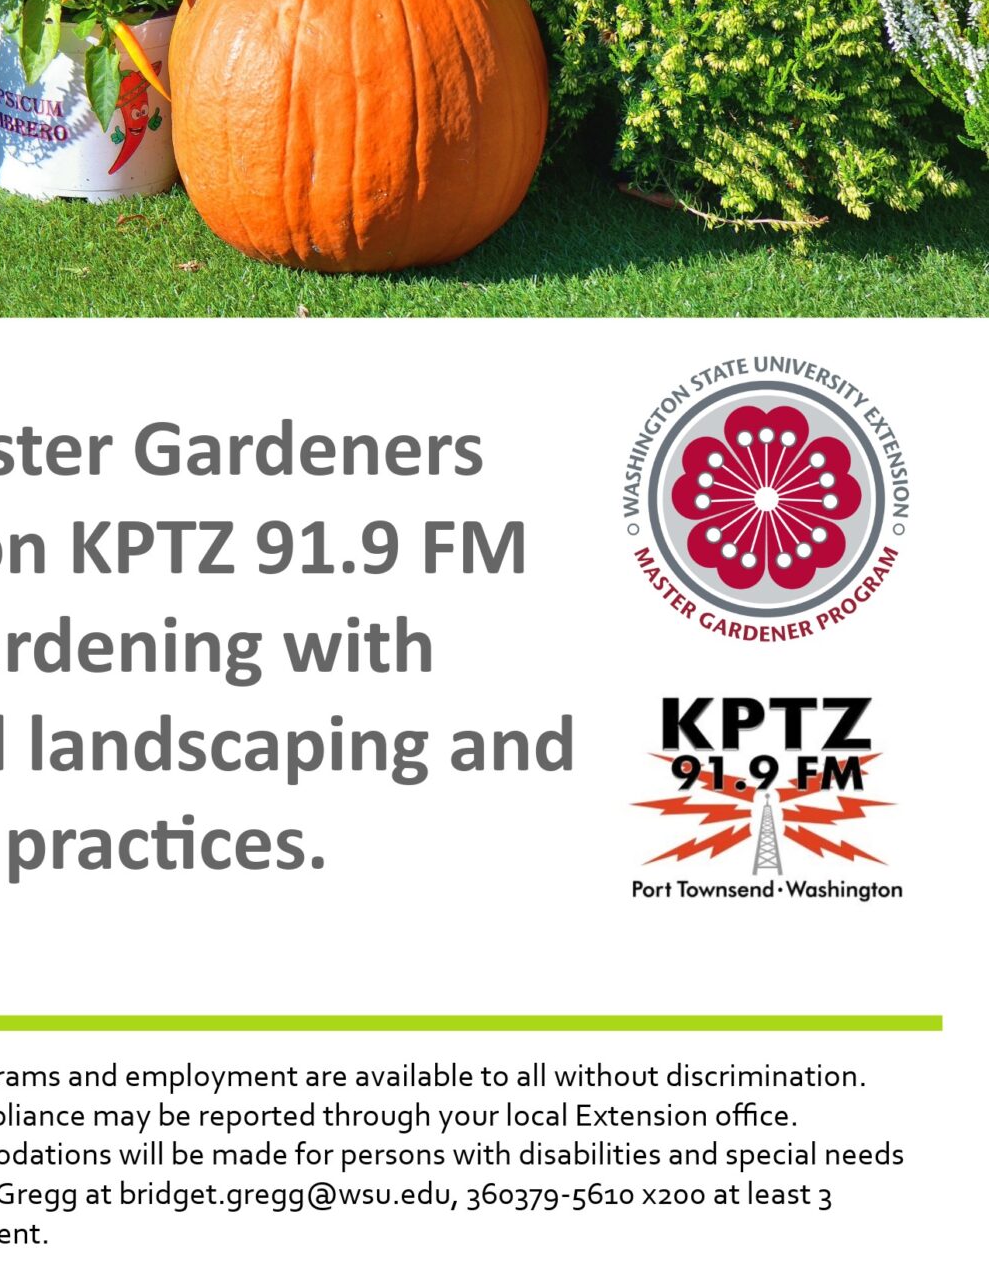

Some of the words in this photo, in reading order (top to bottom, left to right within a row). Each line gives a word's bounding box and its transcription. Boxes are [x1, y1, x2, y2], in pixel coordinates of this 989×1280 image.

[135, 419, 482, 476] Gardeners
[623, 385, 690, 518] WASHINGTON
[690, 358, 749, 391] STATE
[754, 356, 869, 408] UNIVERSITY
[863, 406, 909, 518] EXTENSION
[74, 521, 234, 573] KPTZ
[257, 521, 398, 574] 91.9
[425, 521, 524, 573] FM
[634, 547, 697, 619] MASTER
[699, 612, 813, 642] GARDENER
[816, 546, 899, 630] PROGRAM
[283, 616, 431, 673] with
[32, 714, 428, 785] landscaping
[451, 714, 572, 771] and
[662, 697, 872, 750] KPTZ
[671, 754, 779, 791] 91.9
[797, 756, 864, 790] FM
[9, 814, 324, 884] practices.
[632, 880, 672, 898] Port
[69, 1063, 116, 1086] and
[126, 1063, 298, 1094] employment
[306, 1071, 346, 1086] are
[356, 1063, 472, 1086] available
[481, 1067, 508, 1086] to
[517, 1063, 545, 1086] all
[555, 1063, 658, 1086] without
[667, 1063, 865, 1086] discrimination.
[94, 1111, 151, 1134] may
[160, 1102, 190, 1126] be
[200, 1102, 314, 1134] reported
[323, 1102, 429, 1134] through
[439, 1111, 499, 1134] your
[508, 1102, 566, 1126] local
[577, 1104, 706, 1126] Extension
[716, 1102, 796, 1126] office.
[119, 1141, 162, 1165] will
[173, 1141, 203, 1165] be
[213, 1141, 286, 1165] made
[295, 1141, 334, 1165] for
[342, 1149, 445, 1172] persons
[453, 1141, 510, 1165] with
[520, 1141, 660, 1165] disabilities
[669, 1141, 716, 1165] and
[727, 1141, 815, 1172] special
[826, 1141, 903, 1165] needs
[86, 1185, 111, 1204] at
[121, 1180, 457, 1212] bridget.gregg@wsu.edu,
[467, 1183, 633, 1210] 360379-5610
[714, 1185, 739, 1204] at
[749, 1181, 811, 1204] least
[819, 1189, 831, 1210] 3
